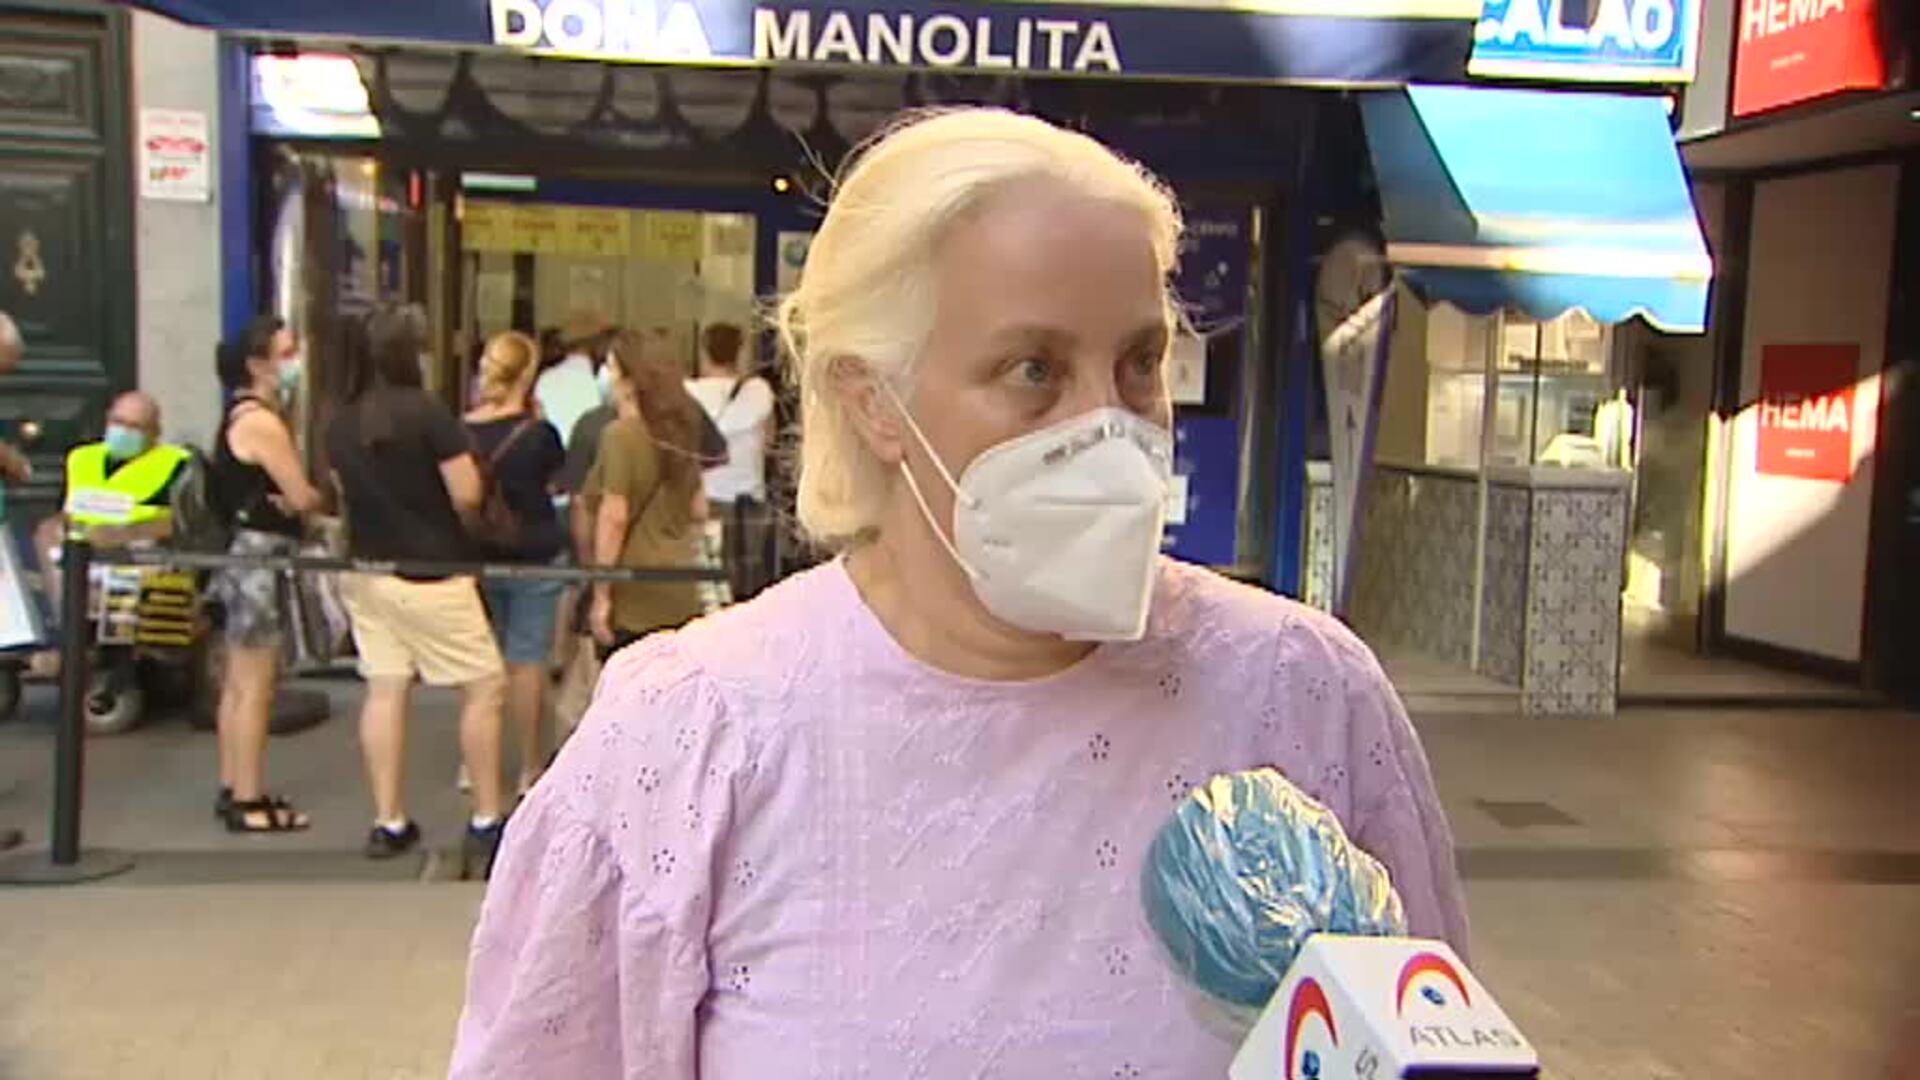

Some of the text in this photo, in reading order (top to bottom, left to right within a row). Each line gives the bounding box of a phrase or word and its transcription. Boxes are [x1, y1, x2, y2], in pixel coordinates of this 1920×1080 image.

[755, 7, 1121, 71] MANOLITA
[1742, 0, 1845, 41] HEMA
[1760, 389, 1849, 433] HEMA
[1409, 1024, 1520, 1049] ATLAS
